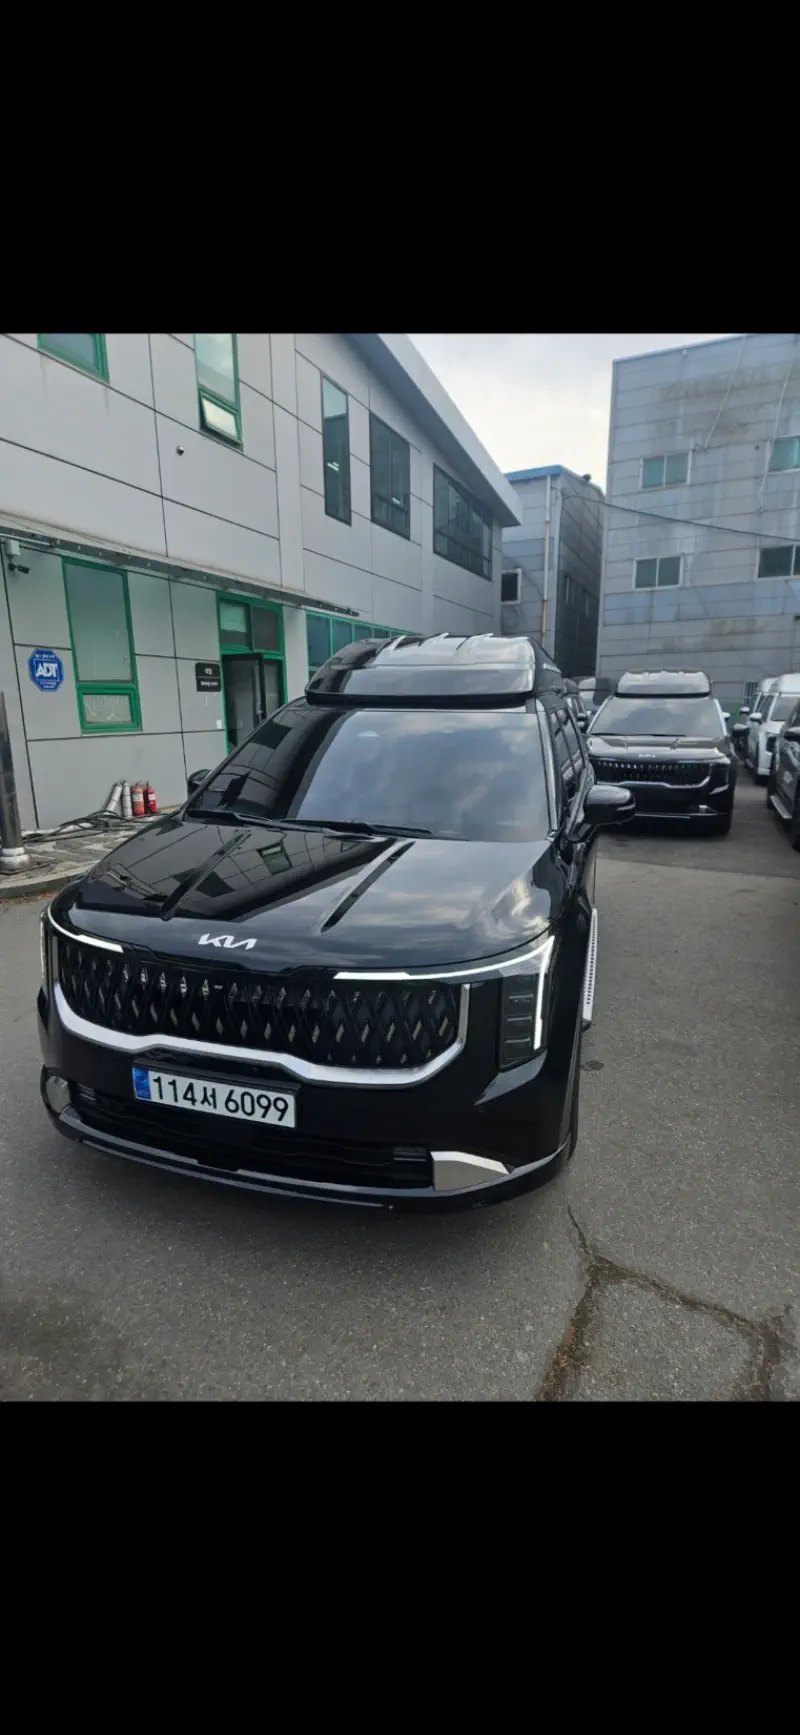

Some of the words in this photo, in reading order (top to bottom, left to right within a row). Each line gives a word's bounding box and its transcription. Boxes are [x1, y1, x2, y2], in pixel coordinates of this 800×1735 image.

[36, 662, 58, 677] ADT
[153, 1076, 217, 1109] 114서
[224, 1089, 289, 1121] 6099
